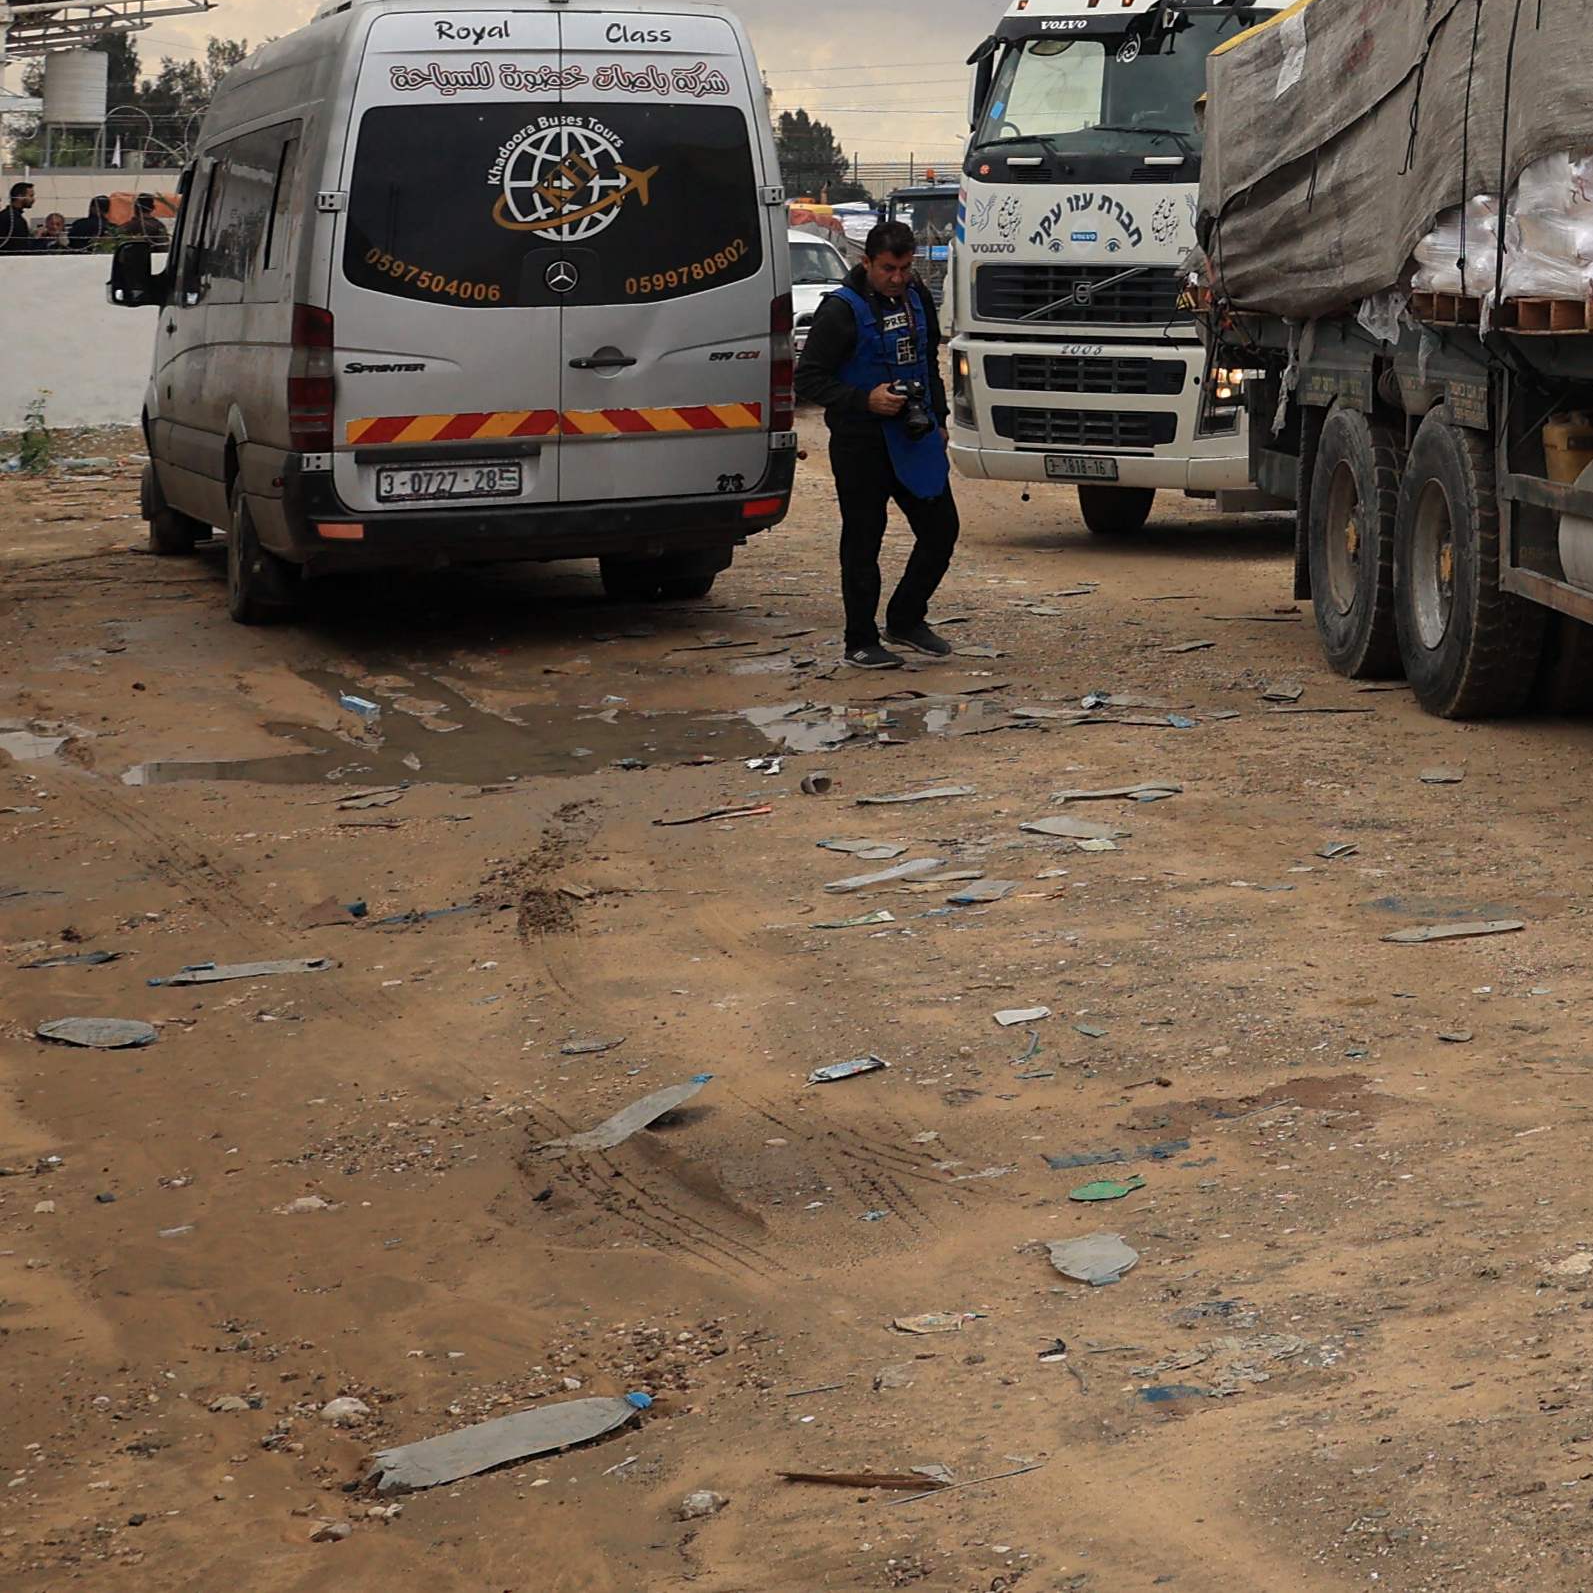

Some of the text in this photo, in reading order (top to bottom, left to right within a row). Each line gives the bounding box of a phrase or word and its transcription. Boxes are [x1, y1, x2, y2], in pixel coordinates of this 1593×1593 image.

[434, 20, 673, 46] Royal Class
[1040, 19, 1088, 31] VOLVO
[389, 61, 730, 97] شركة باصات خضورة للسياحة
[487, 115, 625, 185] Khadoora Buses Tours
[1097, 194, 1143, 248] חברת
[971, 243, 1016, 254] VOLVO
[1072, 233, 1097, 241] VOLVO
[364, 238, 749, 302] 0597504006 0599780802
[709, 350, 762, 362] 519 CDI
